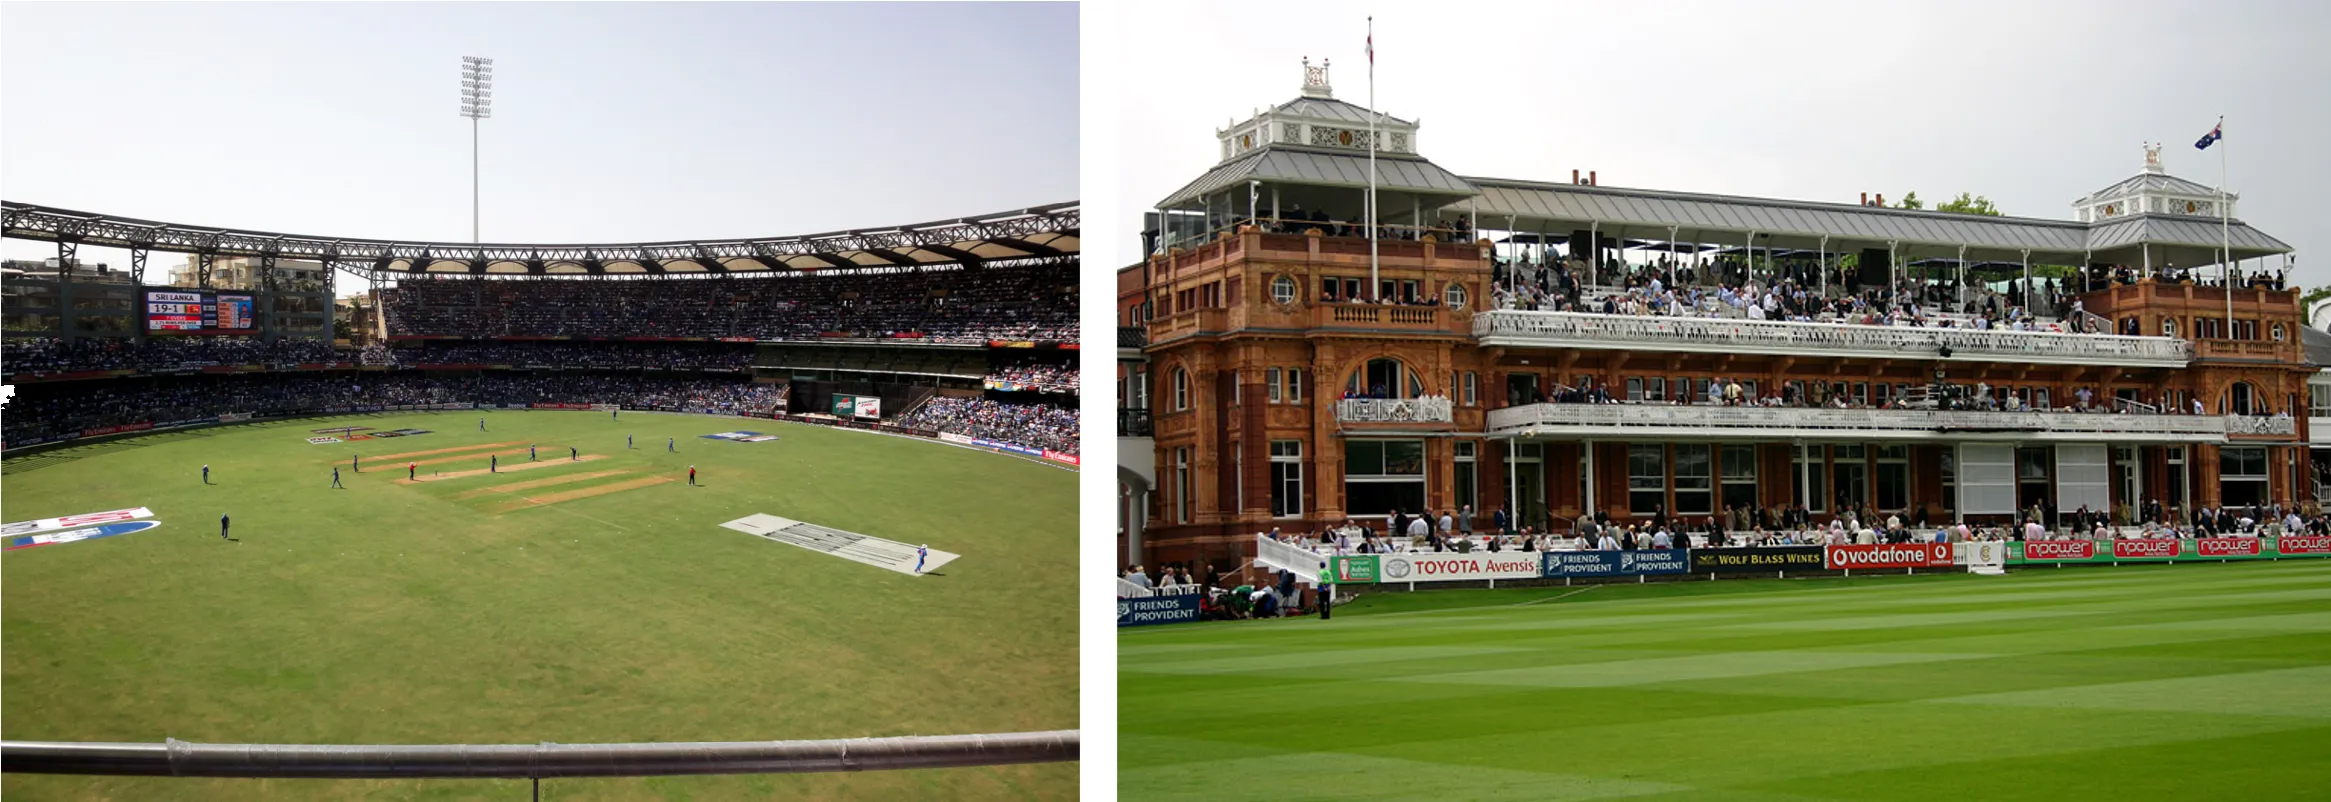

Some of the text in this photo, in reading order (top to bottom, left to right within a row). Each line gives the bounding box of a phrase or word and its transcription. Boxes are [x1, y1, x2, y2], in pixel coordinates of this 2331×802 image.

[155, 304, 178, 312] 19-1
[2028, 542, 2089, 557] npower
[2118, 541, 2174, 555] npower
[2201, 540, 2256, 554] npower
[1564, 555, 1600, 563] FRIENDS
[1636, 553, 1672, 561] FRIENDS
[1848, 546, 1924, 564] vodafone
[1415, 558, 1534, 574] TOYOTA Avensis
[1564, 564, 1612, 573] PROVIDENT
[1637, 562, 1683, 571] PROVIDENT
[1134, 599, 1179, 610] FRIENDS
[1134, 609, 1194, 621] PROVIDENT
